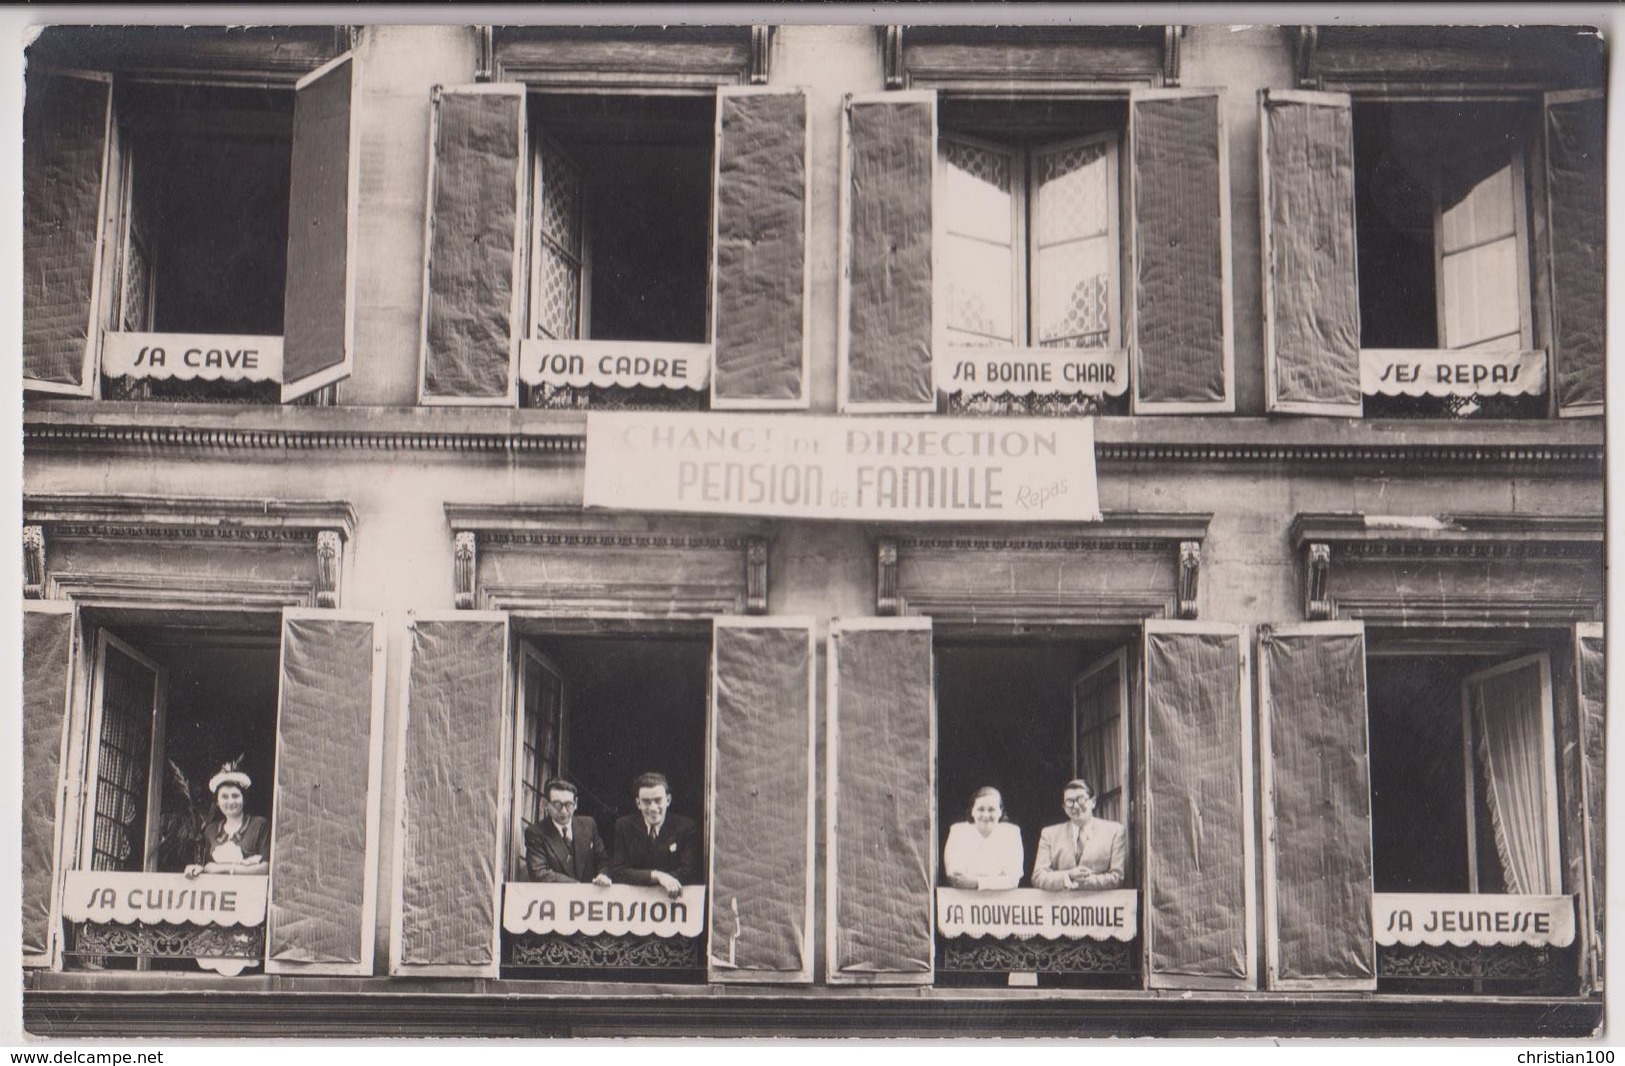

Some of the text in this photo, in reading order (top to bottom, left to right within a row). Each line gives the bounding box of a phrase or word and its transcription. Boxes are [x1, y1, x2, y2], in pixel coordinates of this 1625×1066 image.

[134, 346, 258, 368] SA CAVE
[539, 354, 687, 378] SON CADRE
[953, 362, 1115, 383] SA BONNE CHAIR
[1381, 364, 1521, 383] SES REPAS
[846, 430, 1056, 456] DIRECTION
[677, 460, 823, 507] PENSION
[856, 465, 1003, 509] FAMILLE
[1015, 478, 1068, 510] Repas
[87, 888, 237, 911] SA CUISINE
[522, 900, 687, 923] SA PENSION
[946, 905, 1124, 927] SA NOUVELLE FORMULE
[1387, 910, 1549, 933] SA JEUNESSE
